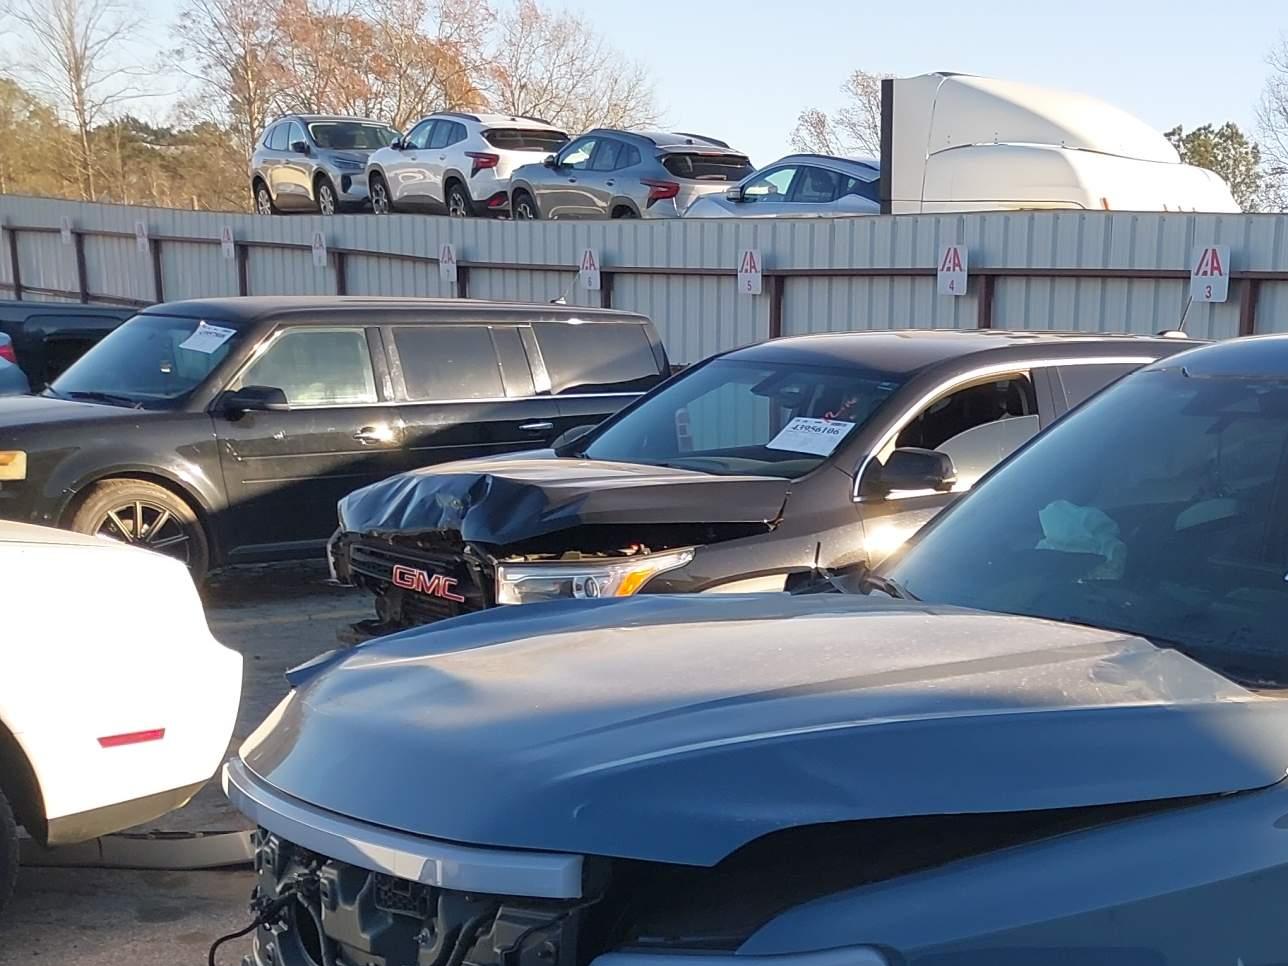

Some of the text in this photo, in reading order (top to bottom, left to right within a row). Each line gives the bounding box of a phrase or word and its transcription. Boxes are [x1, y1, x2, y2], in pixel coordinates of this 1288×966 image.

[747, 280, 752, 291] 5
[949, 279, 955, 291] 4
[1205, 285, 1212, 298] 3
[392, 564, 464, 603] GMC
